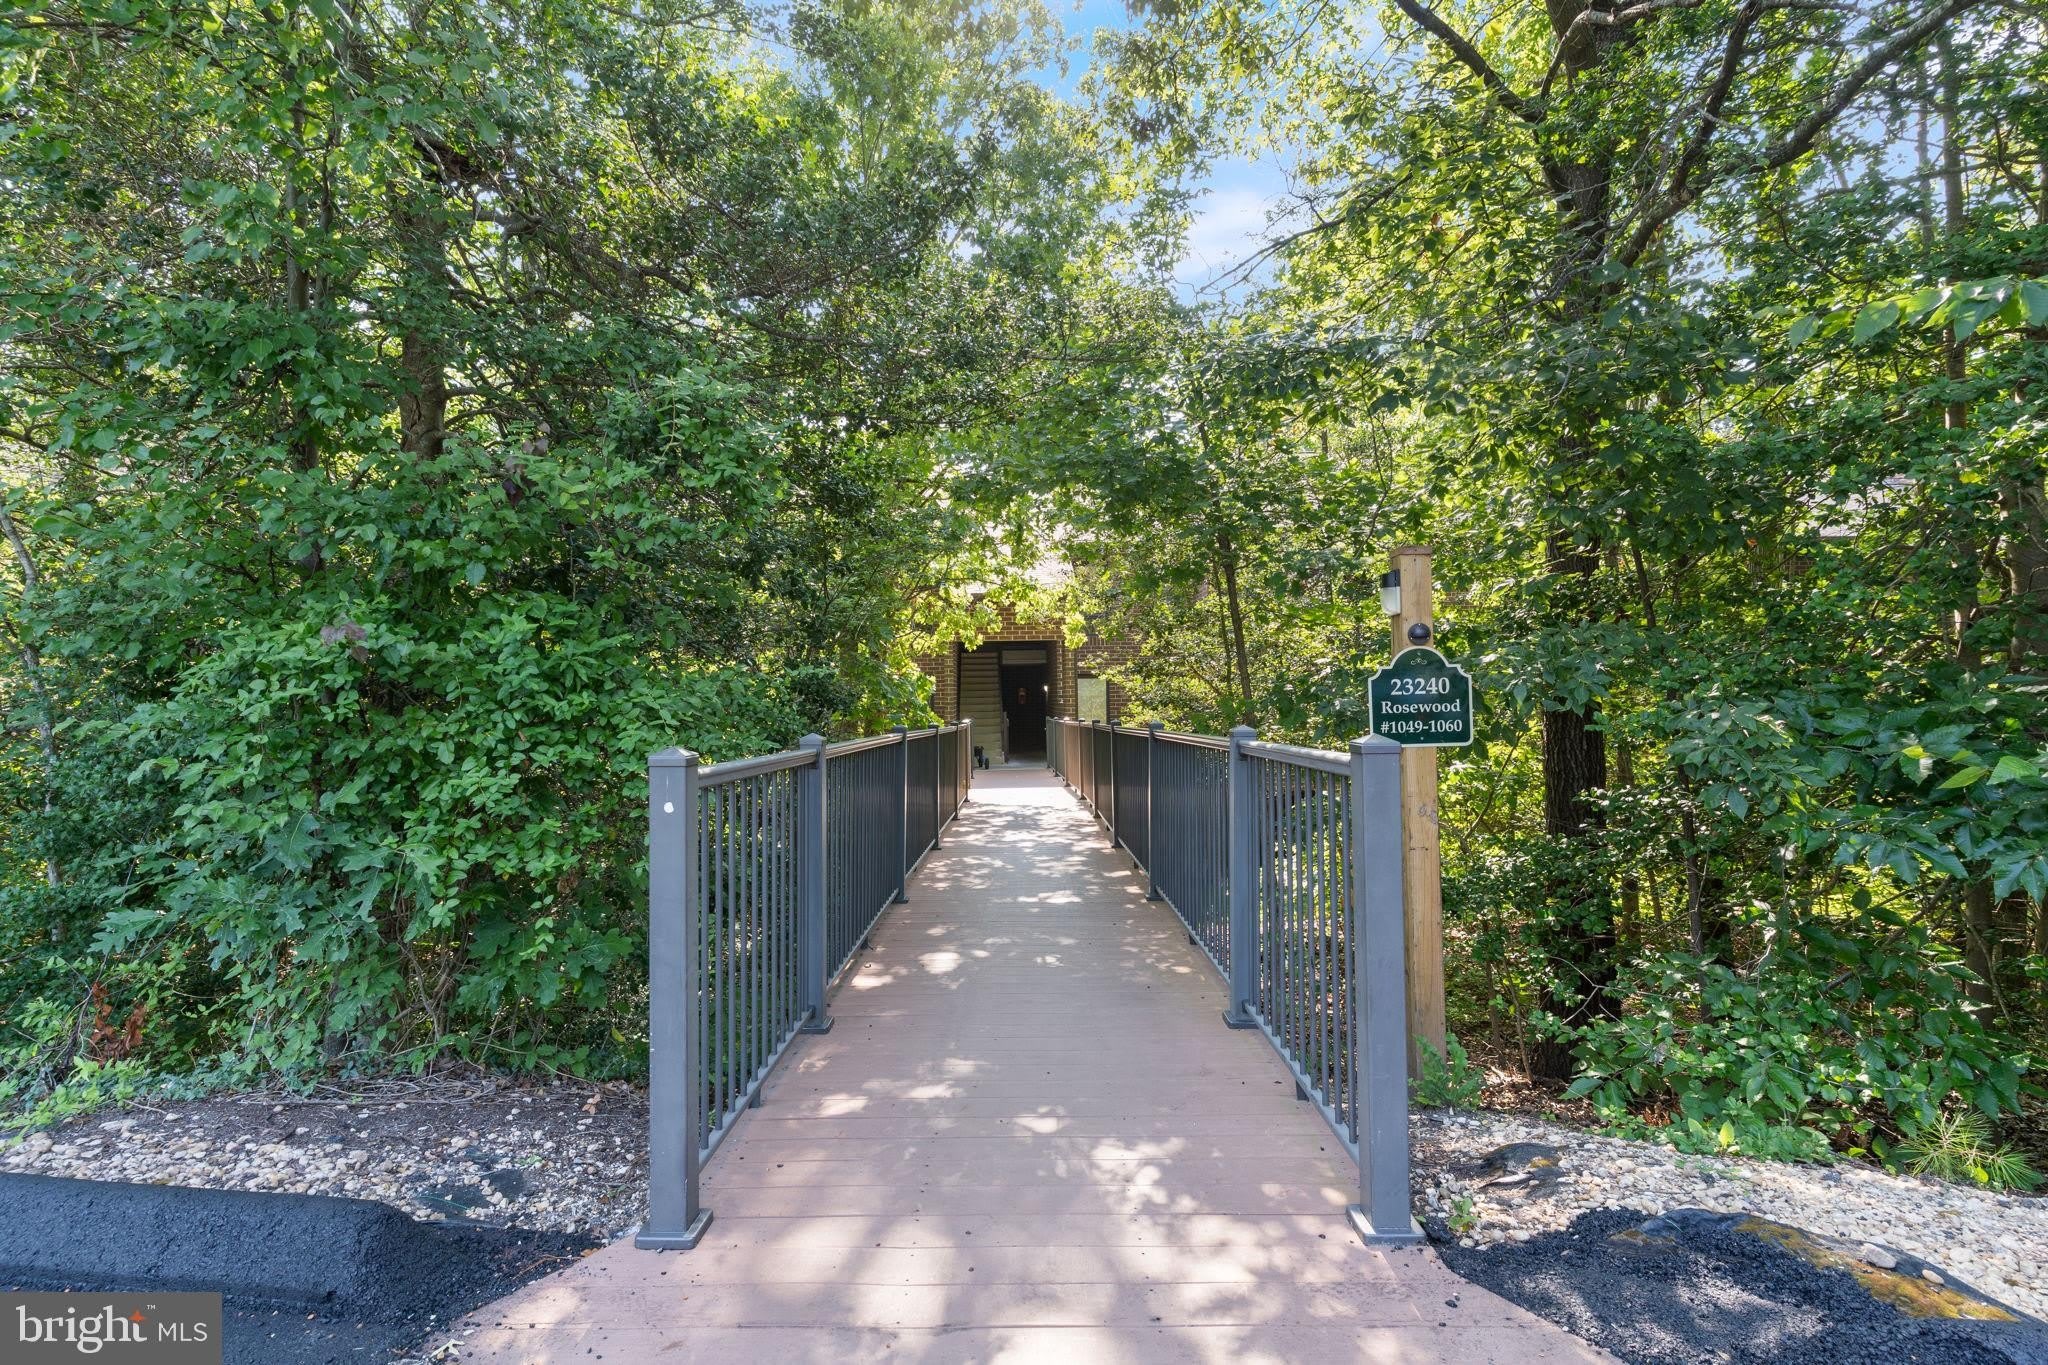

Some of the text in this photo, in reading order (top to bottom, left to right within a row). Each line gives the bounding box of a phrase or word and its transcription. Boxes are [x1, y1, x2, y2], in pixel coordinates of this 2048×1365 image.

[1390, 677, 1450, 696] 23240
[1381, 699, 1461, 714] Rosewood
[1380, 719, 1463, 734] #1049-1060
